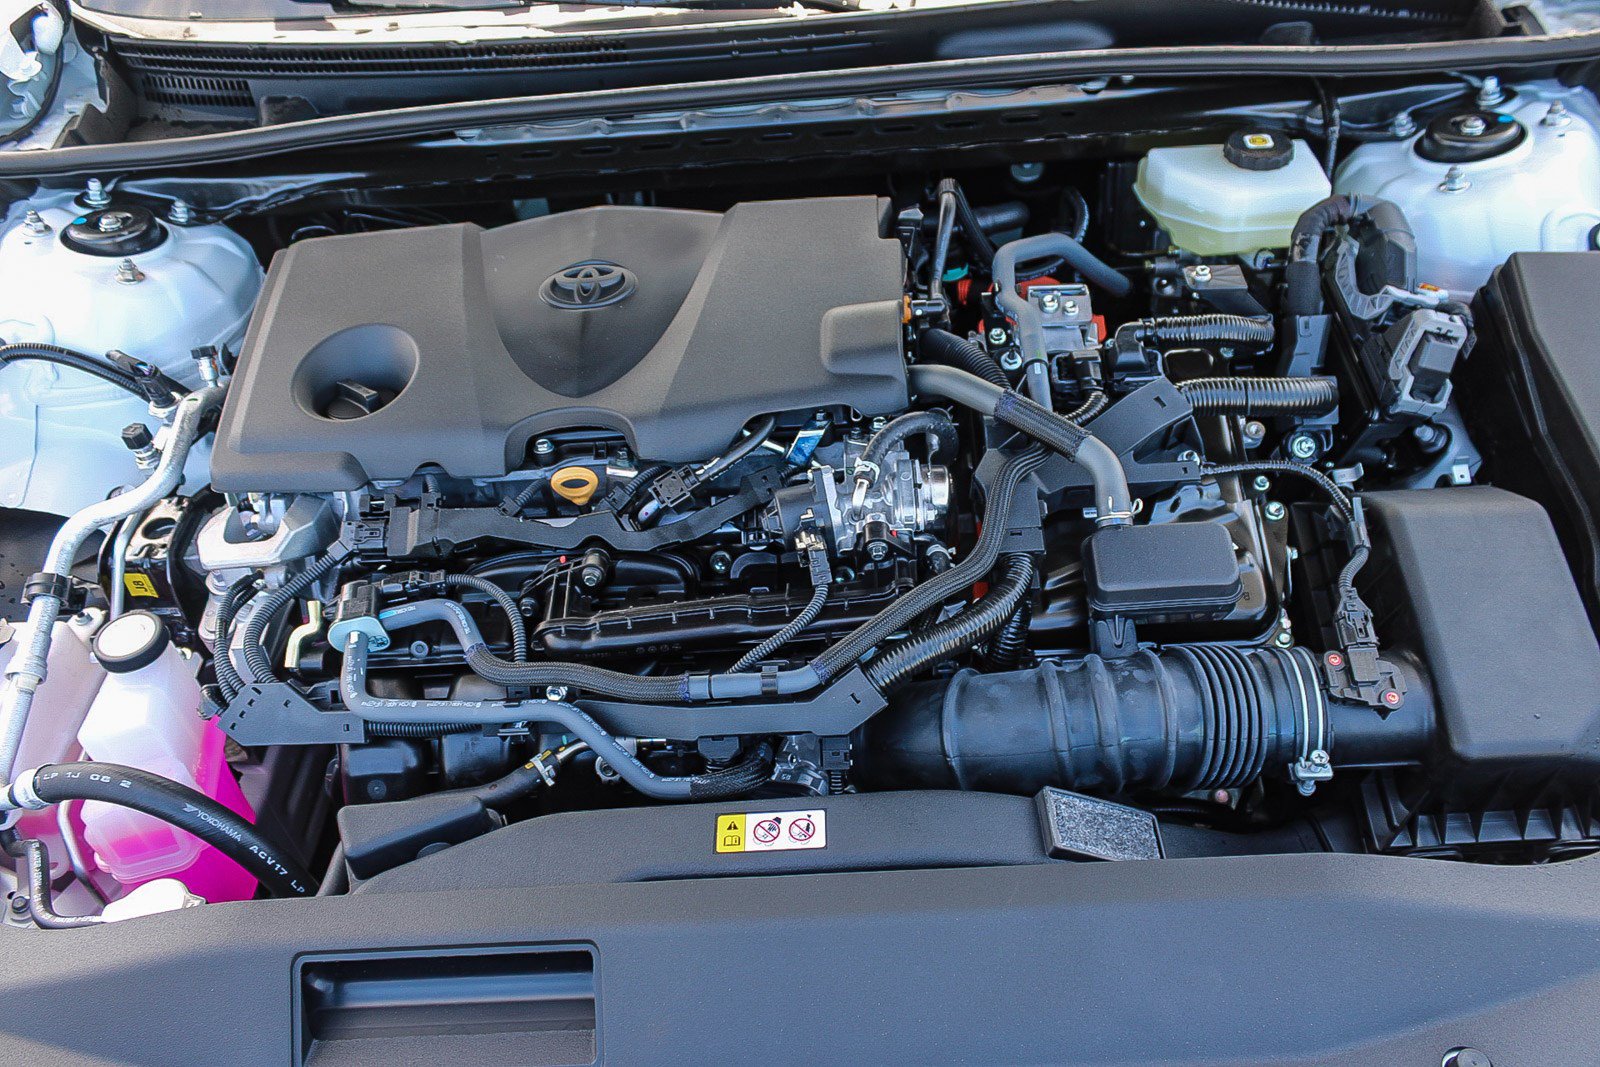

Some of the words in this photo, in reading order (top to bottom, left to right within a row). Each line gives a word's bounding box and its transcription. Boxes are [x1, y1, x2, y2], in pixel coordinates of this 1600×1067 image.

[43, 772, 59, 780] LP
[119, 779, 132, 789] 2
[196, 809, 242, 842] YOKOHAMA
[249, 845, 288, 876] ACV17
[290, 879, 305, 893] LP
